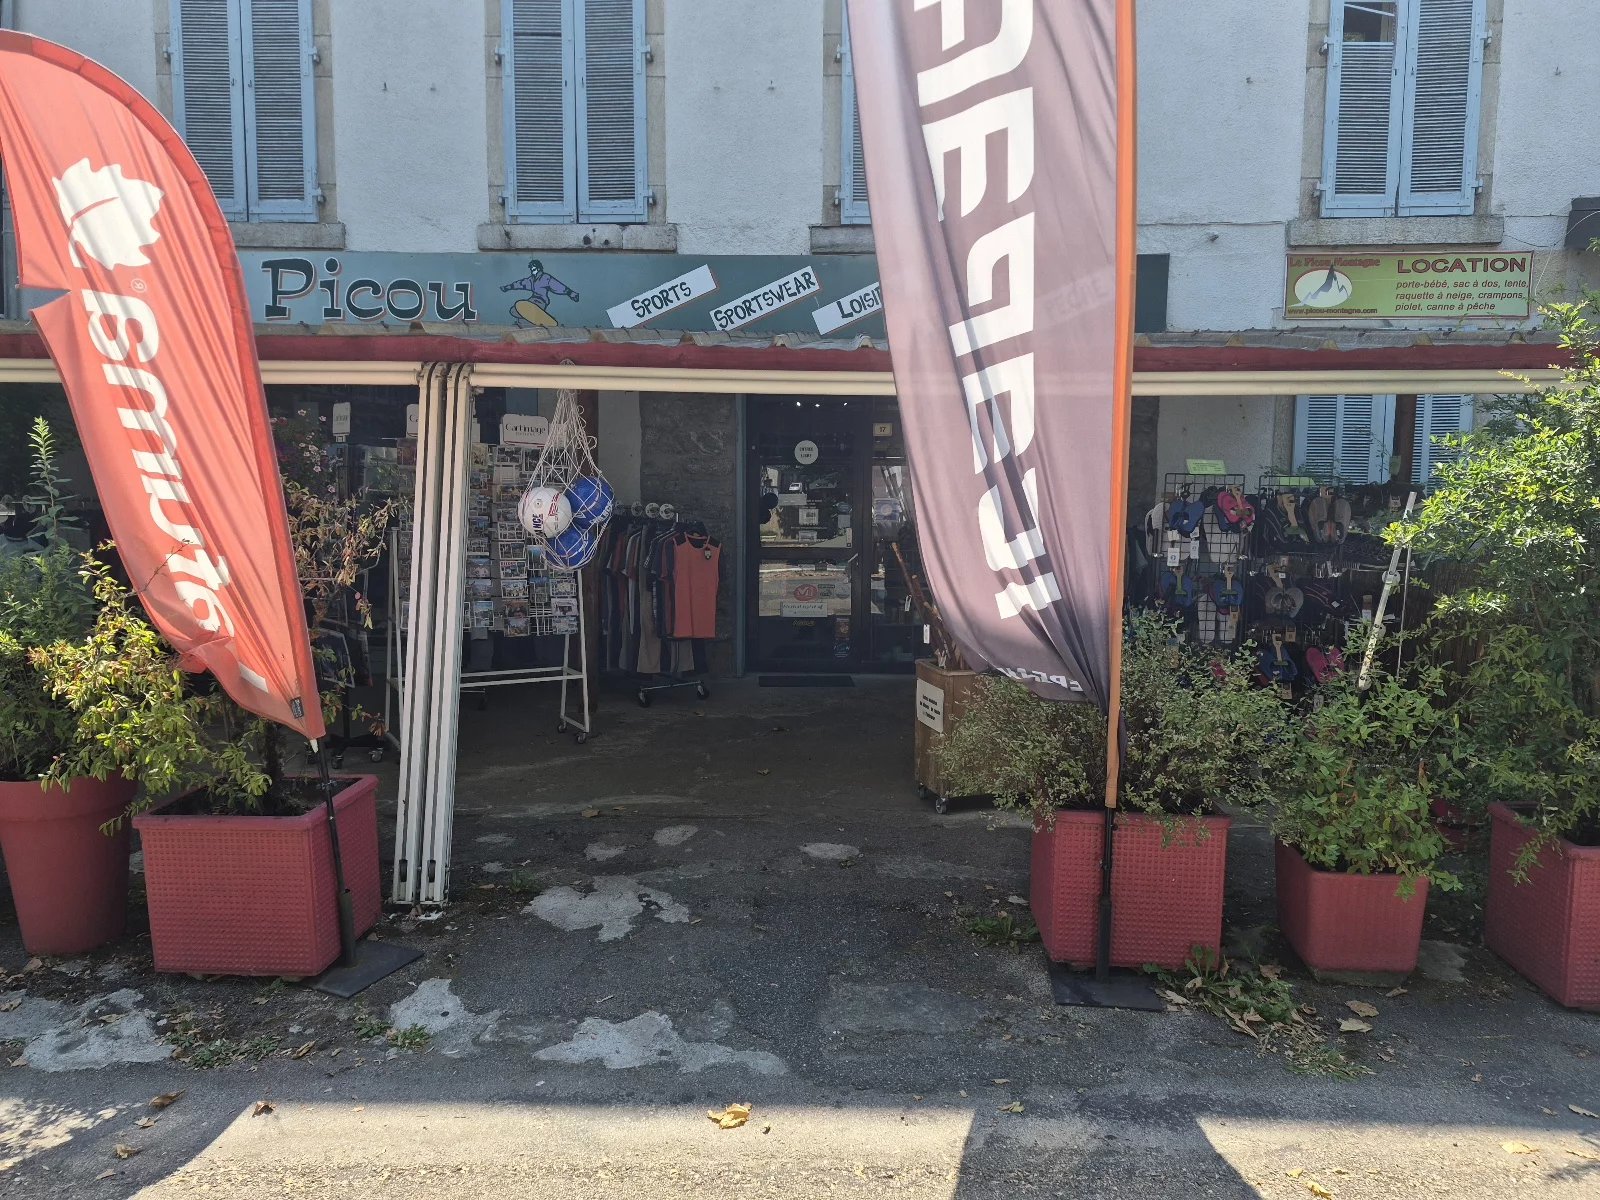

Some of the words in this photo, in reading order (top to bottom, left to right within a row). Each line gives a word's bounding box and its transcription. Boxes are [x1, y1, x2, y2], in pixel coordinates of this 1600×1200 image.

[1304, 257, 1333, 267] Picou
[1333, 257, 1381, 269] Montagne
[1397, 257, 1527, 274] LOCATION
[261, 256, 478, 322] Picou
[1395, 279, 1449, 290] porte-bébé,
[1472, 279, 1479, 288] à
[1481, 279, 1500, 289] dos,
[1504, 279, 1529, 289] tente,
[630, 281, 692, 318] SPORTS
[713, 271, 816, 329] SPORTSWEAR
[1395, 291, 1435, 301] raquette
[1436, 291, 1443, 300] à
[1446, 291, 1475, 301] neige,
[1477, 291, 1525, 301] crampons,
[1287, 307, 1378, 315] www.picou-montagne.com
[1394, 302, 1423, 312] piolet,
[1426, 303, 1456, 311] canne
[1457, 302, 1464, 310] à
[1466, 301, 1496, 312] pêche
